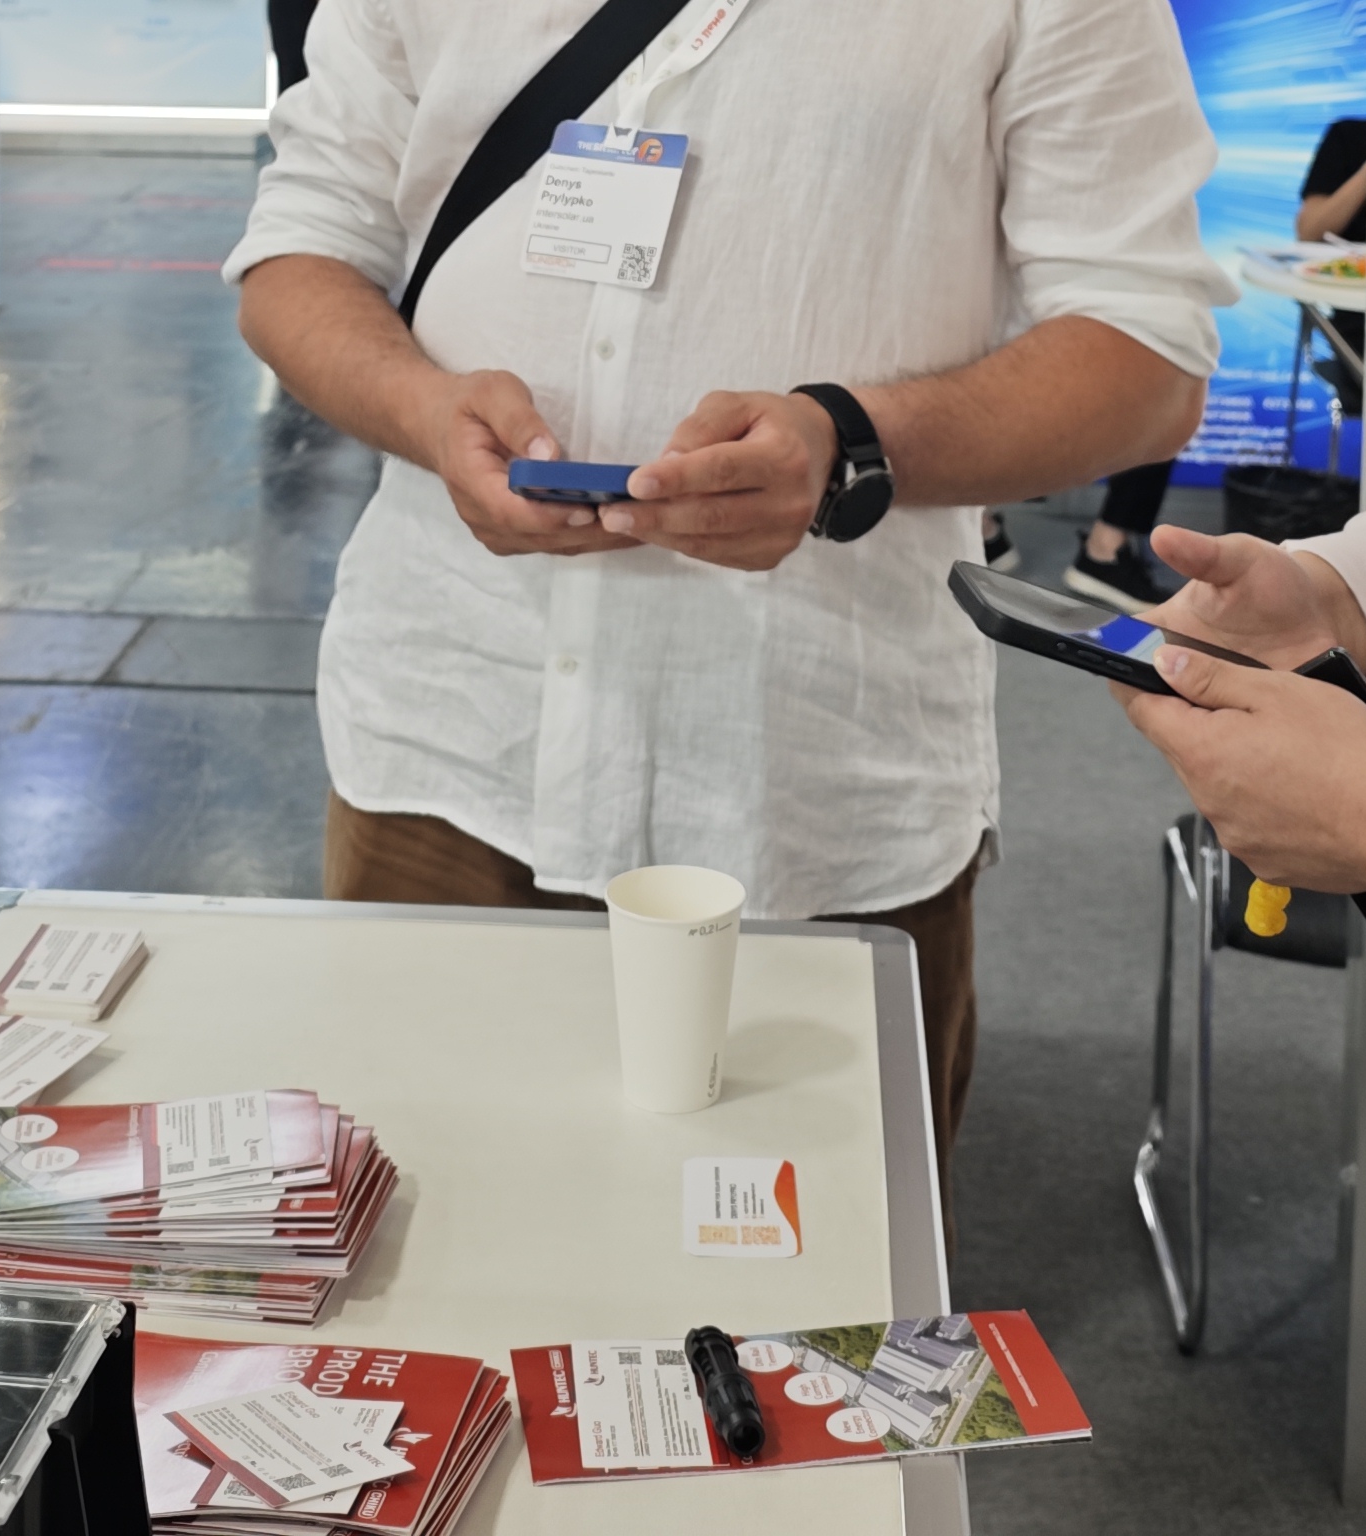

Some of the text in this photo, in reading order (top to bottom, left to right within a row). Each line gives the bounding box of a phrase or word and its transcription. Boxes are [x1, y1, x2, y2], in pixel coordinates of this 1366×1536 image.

[544, 174, 583, 190] Denys
[540, 189, 594, 208] Prylypko
[274, 1348, 319, 1382] BRO
[311, 1348, 363, 1397] PROD
[362, 1353, 408, 1389] THE
[588, 1349, 600, 1375] HUNTEC
[552, 1369, 571, 1404] HUNTEC
[842, 1420, 853, 1434] New
[852, 1415, 866, 1435] Energy
[861, 1409, 879, 1438] Connector
[361, 1491, 383, 1518] CHIKU
